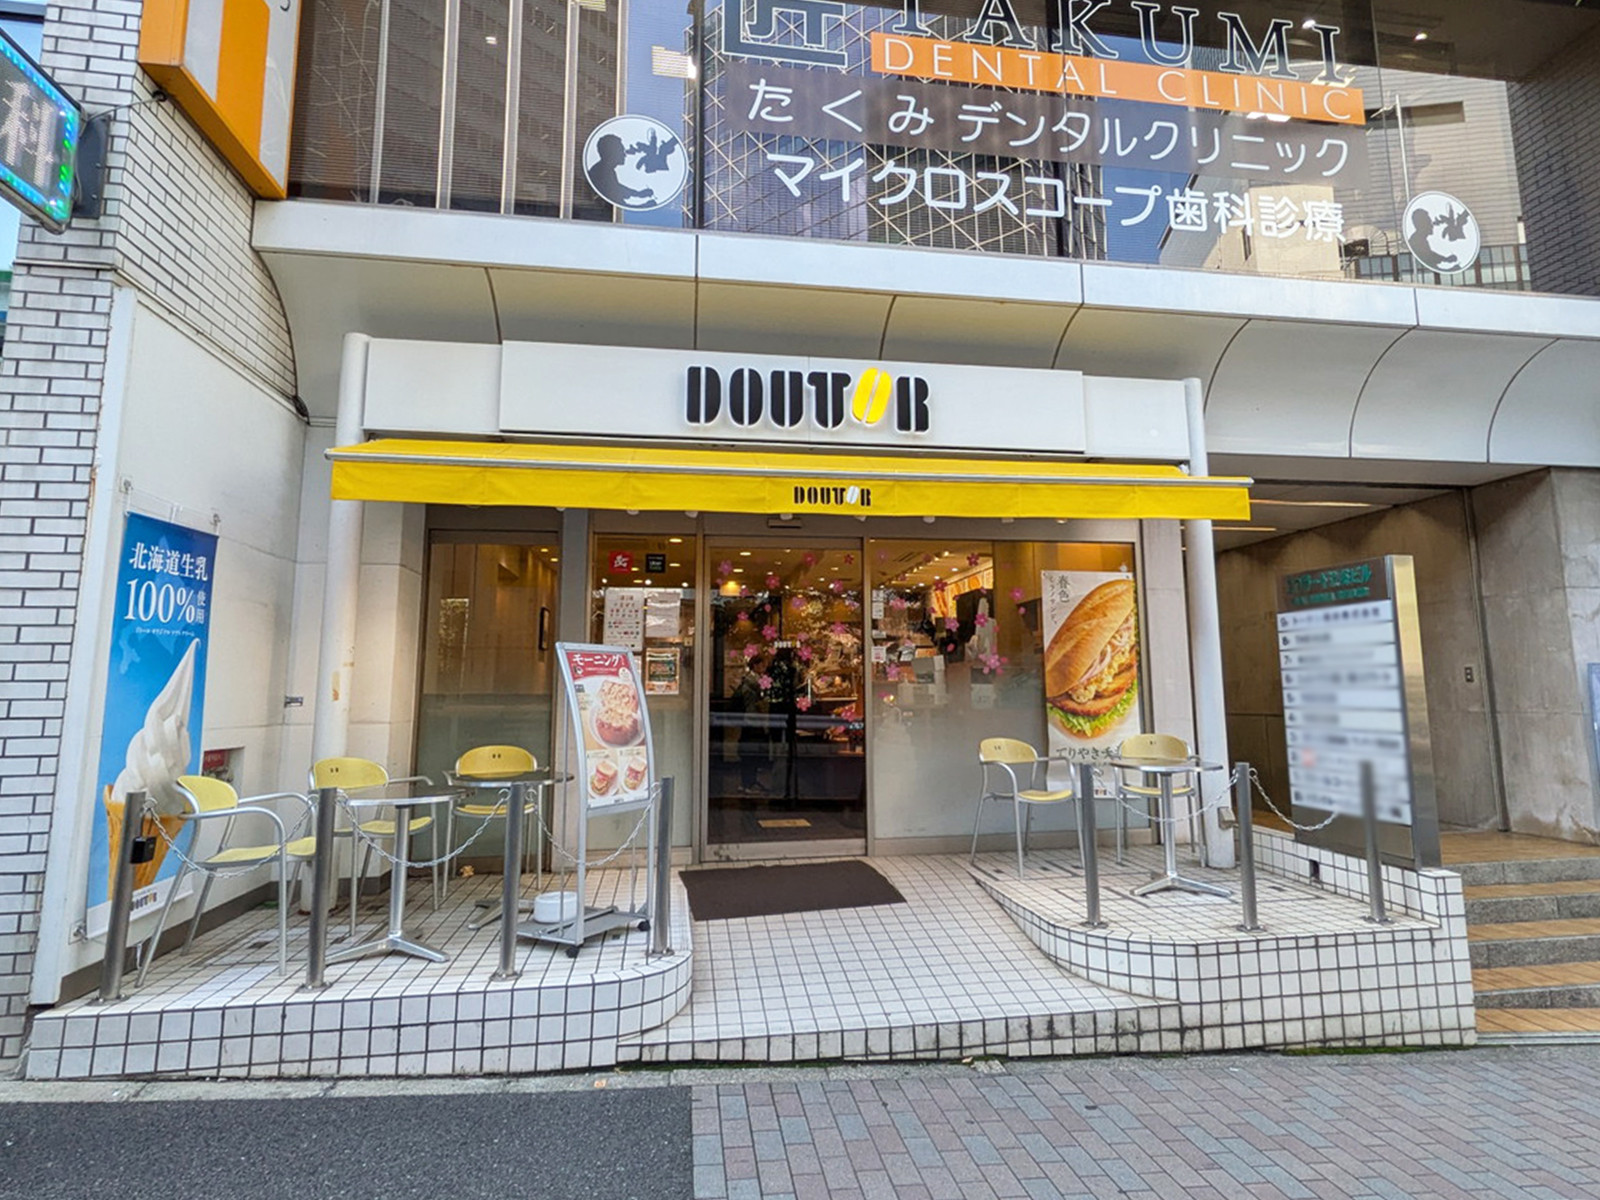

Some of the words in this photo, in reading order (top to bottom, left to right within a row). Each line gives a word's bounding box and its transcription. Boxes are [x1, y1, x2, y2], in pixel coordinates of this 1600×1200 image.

[884, 38, 1117, 95] DENTAL
[1157, 70, 1352, 120] CLINIC
[749, 78, 1349, 176] たくみデンタルクリニック
[767, 153, 1346, 242] マイクロスコープ歯科診療
[686, 366, 930, 432] DOUTOR
[794, 485, 871, 506] DOUTOR
[129, 542, 208, 581] 北海道生乳
[124, 578, 195, 623] 100%
